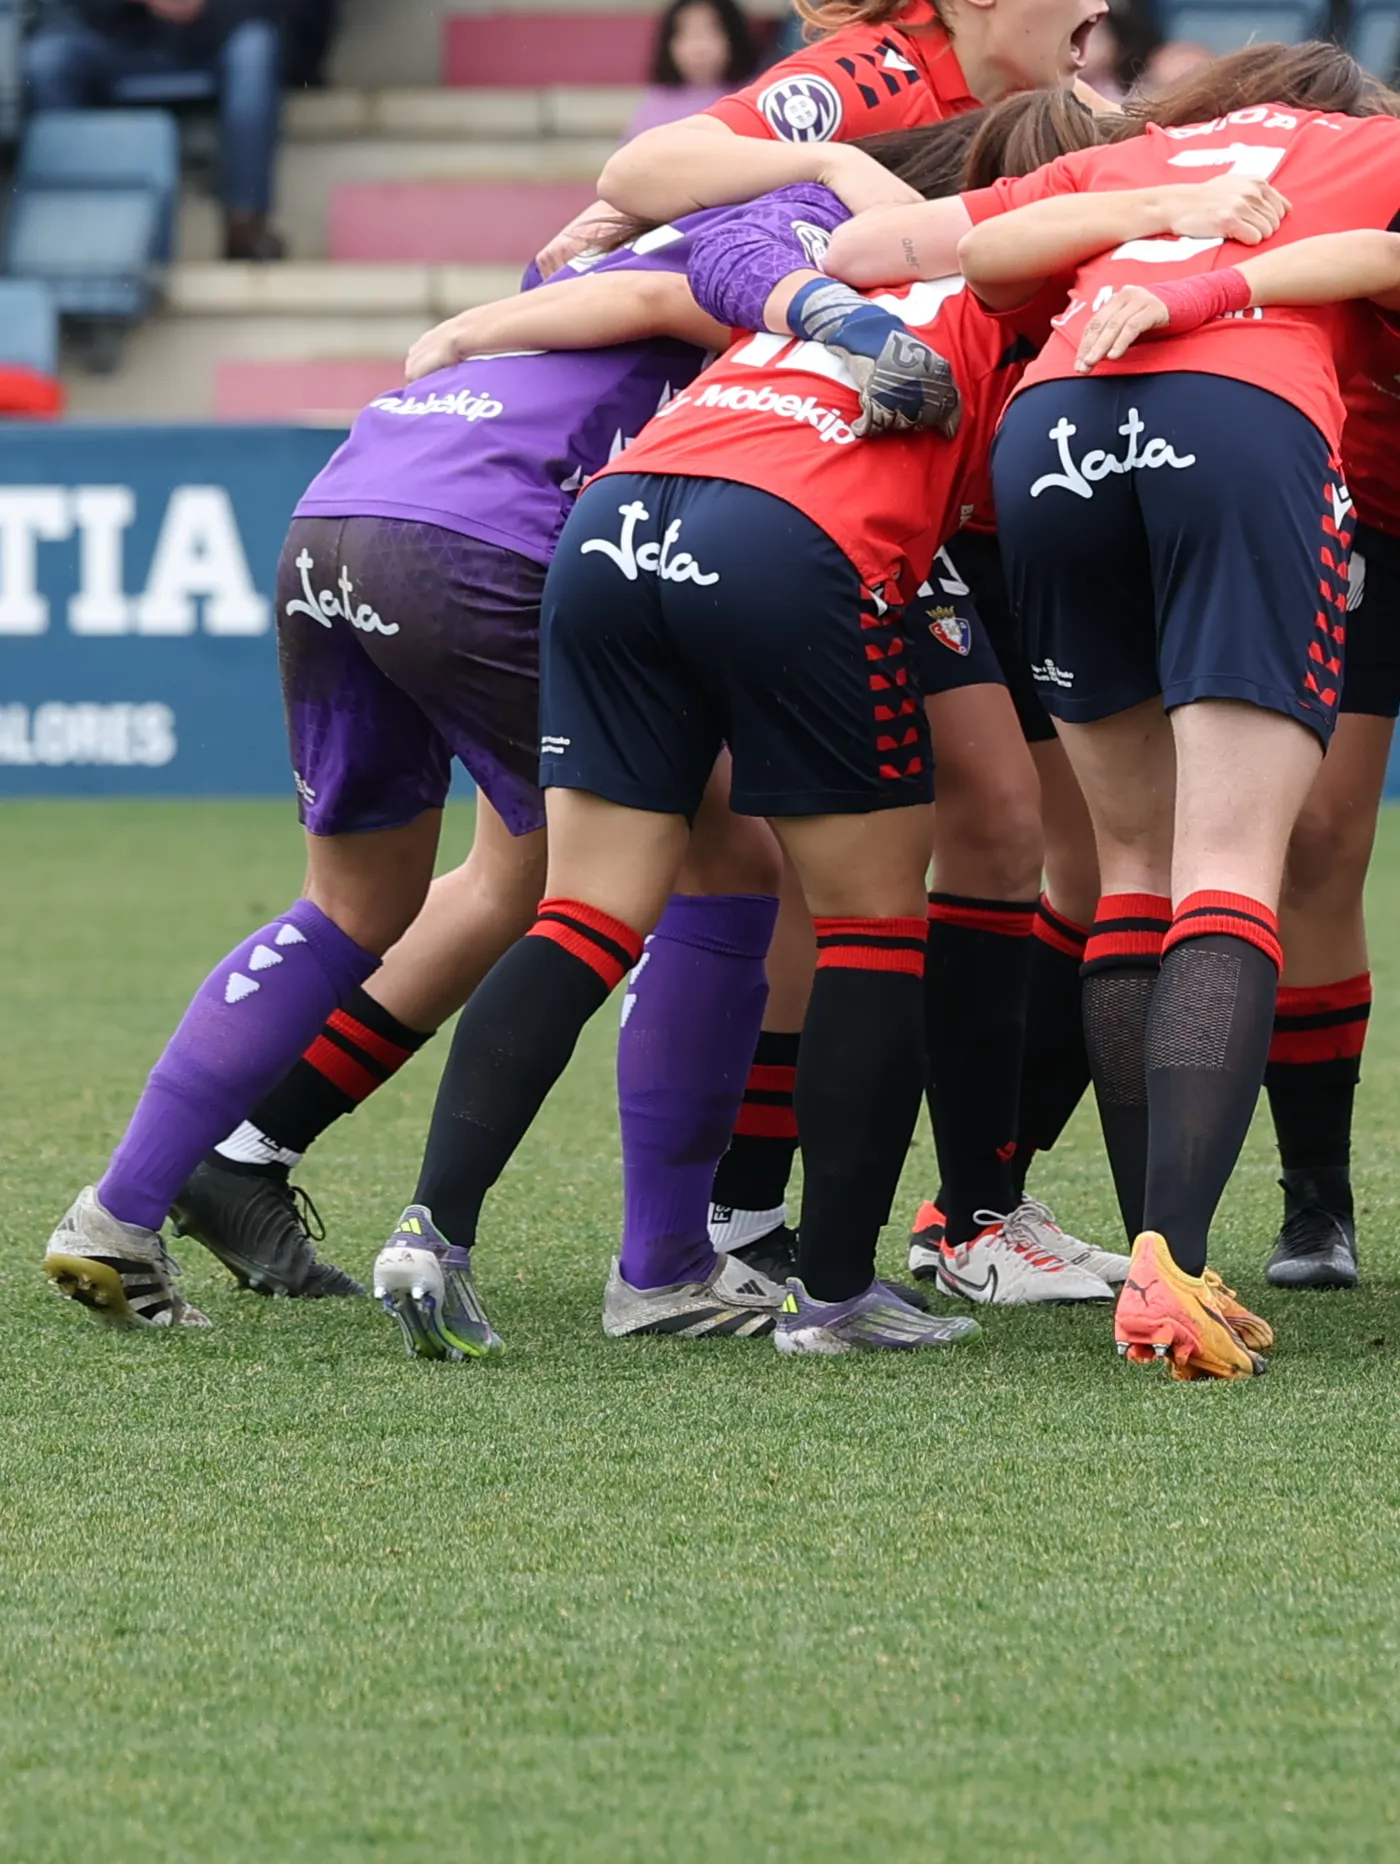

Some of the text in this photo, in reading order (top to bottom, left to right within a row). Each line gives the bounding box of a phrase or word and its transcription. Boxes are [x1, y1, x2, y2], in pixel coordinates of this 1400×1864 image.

[693, 384, 857, 445] Mobekip
[1030, 407, 1197, 499] Jata
[286, 547, 400, 636] Jata
